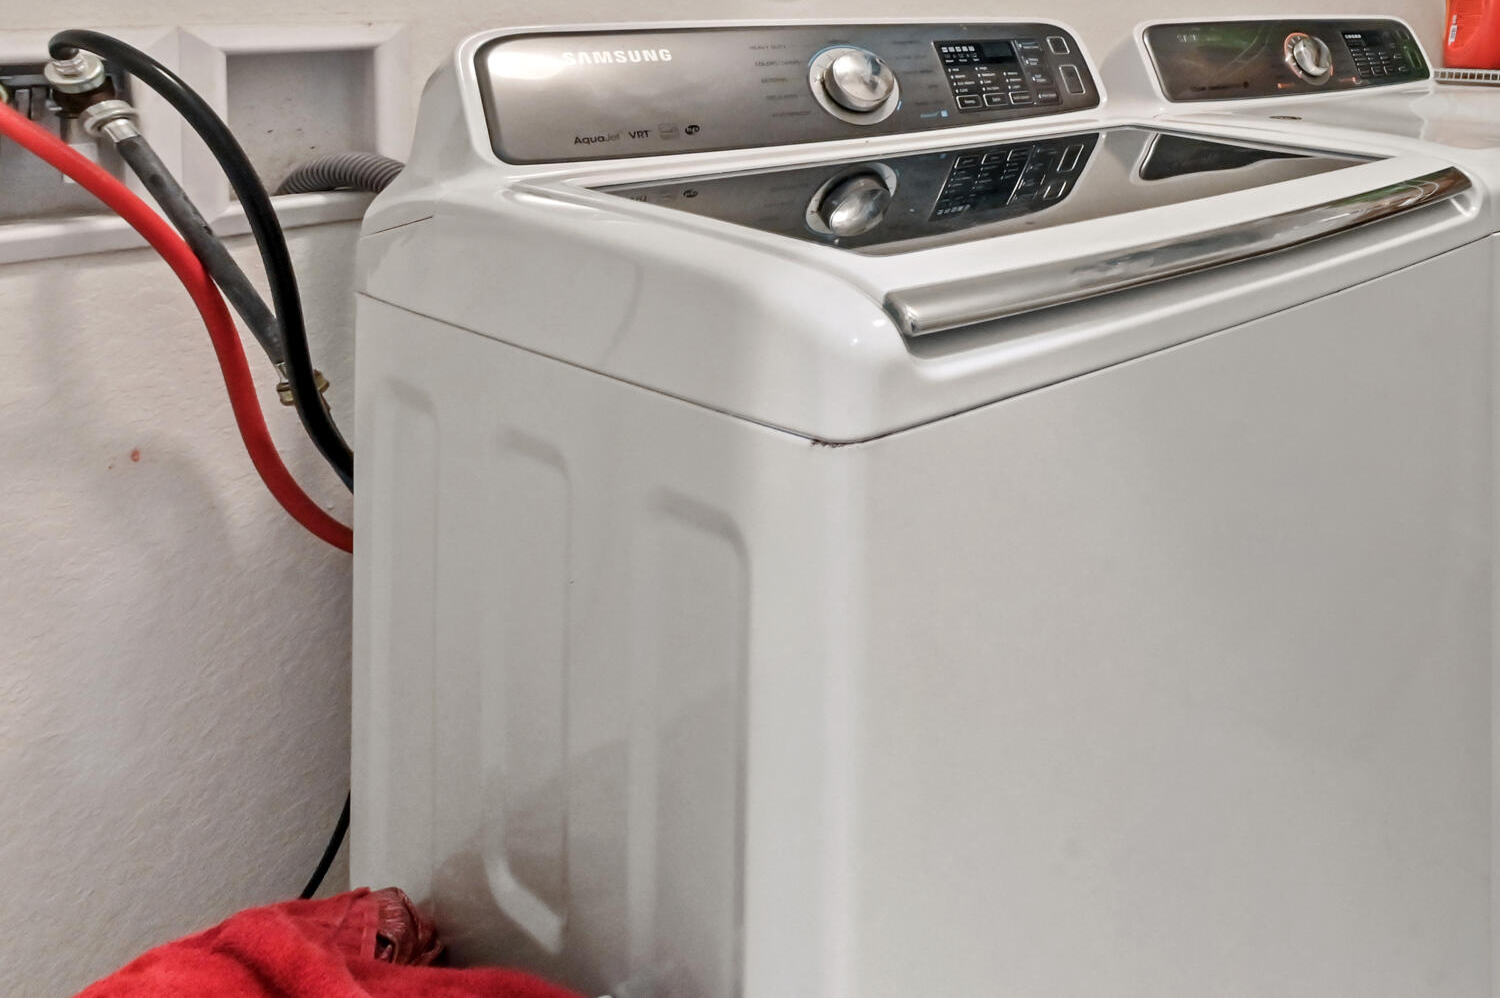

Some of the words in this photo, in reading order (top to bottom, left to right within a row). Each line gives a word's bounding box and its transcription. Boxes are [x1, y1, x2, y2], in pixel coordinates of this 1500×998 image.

[562, 48, 673, 66] SAMSUNG
[574, 132, 621, 146] AquaJet
[628, 130, 650, 140] VRT
